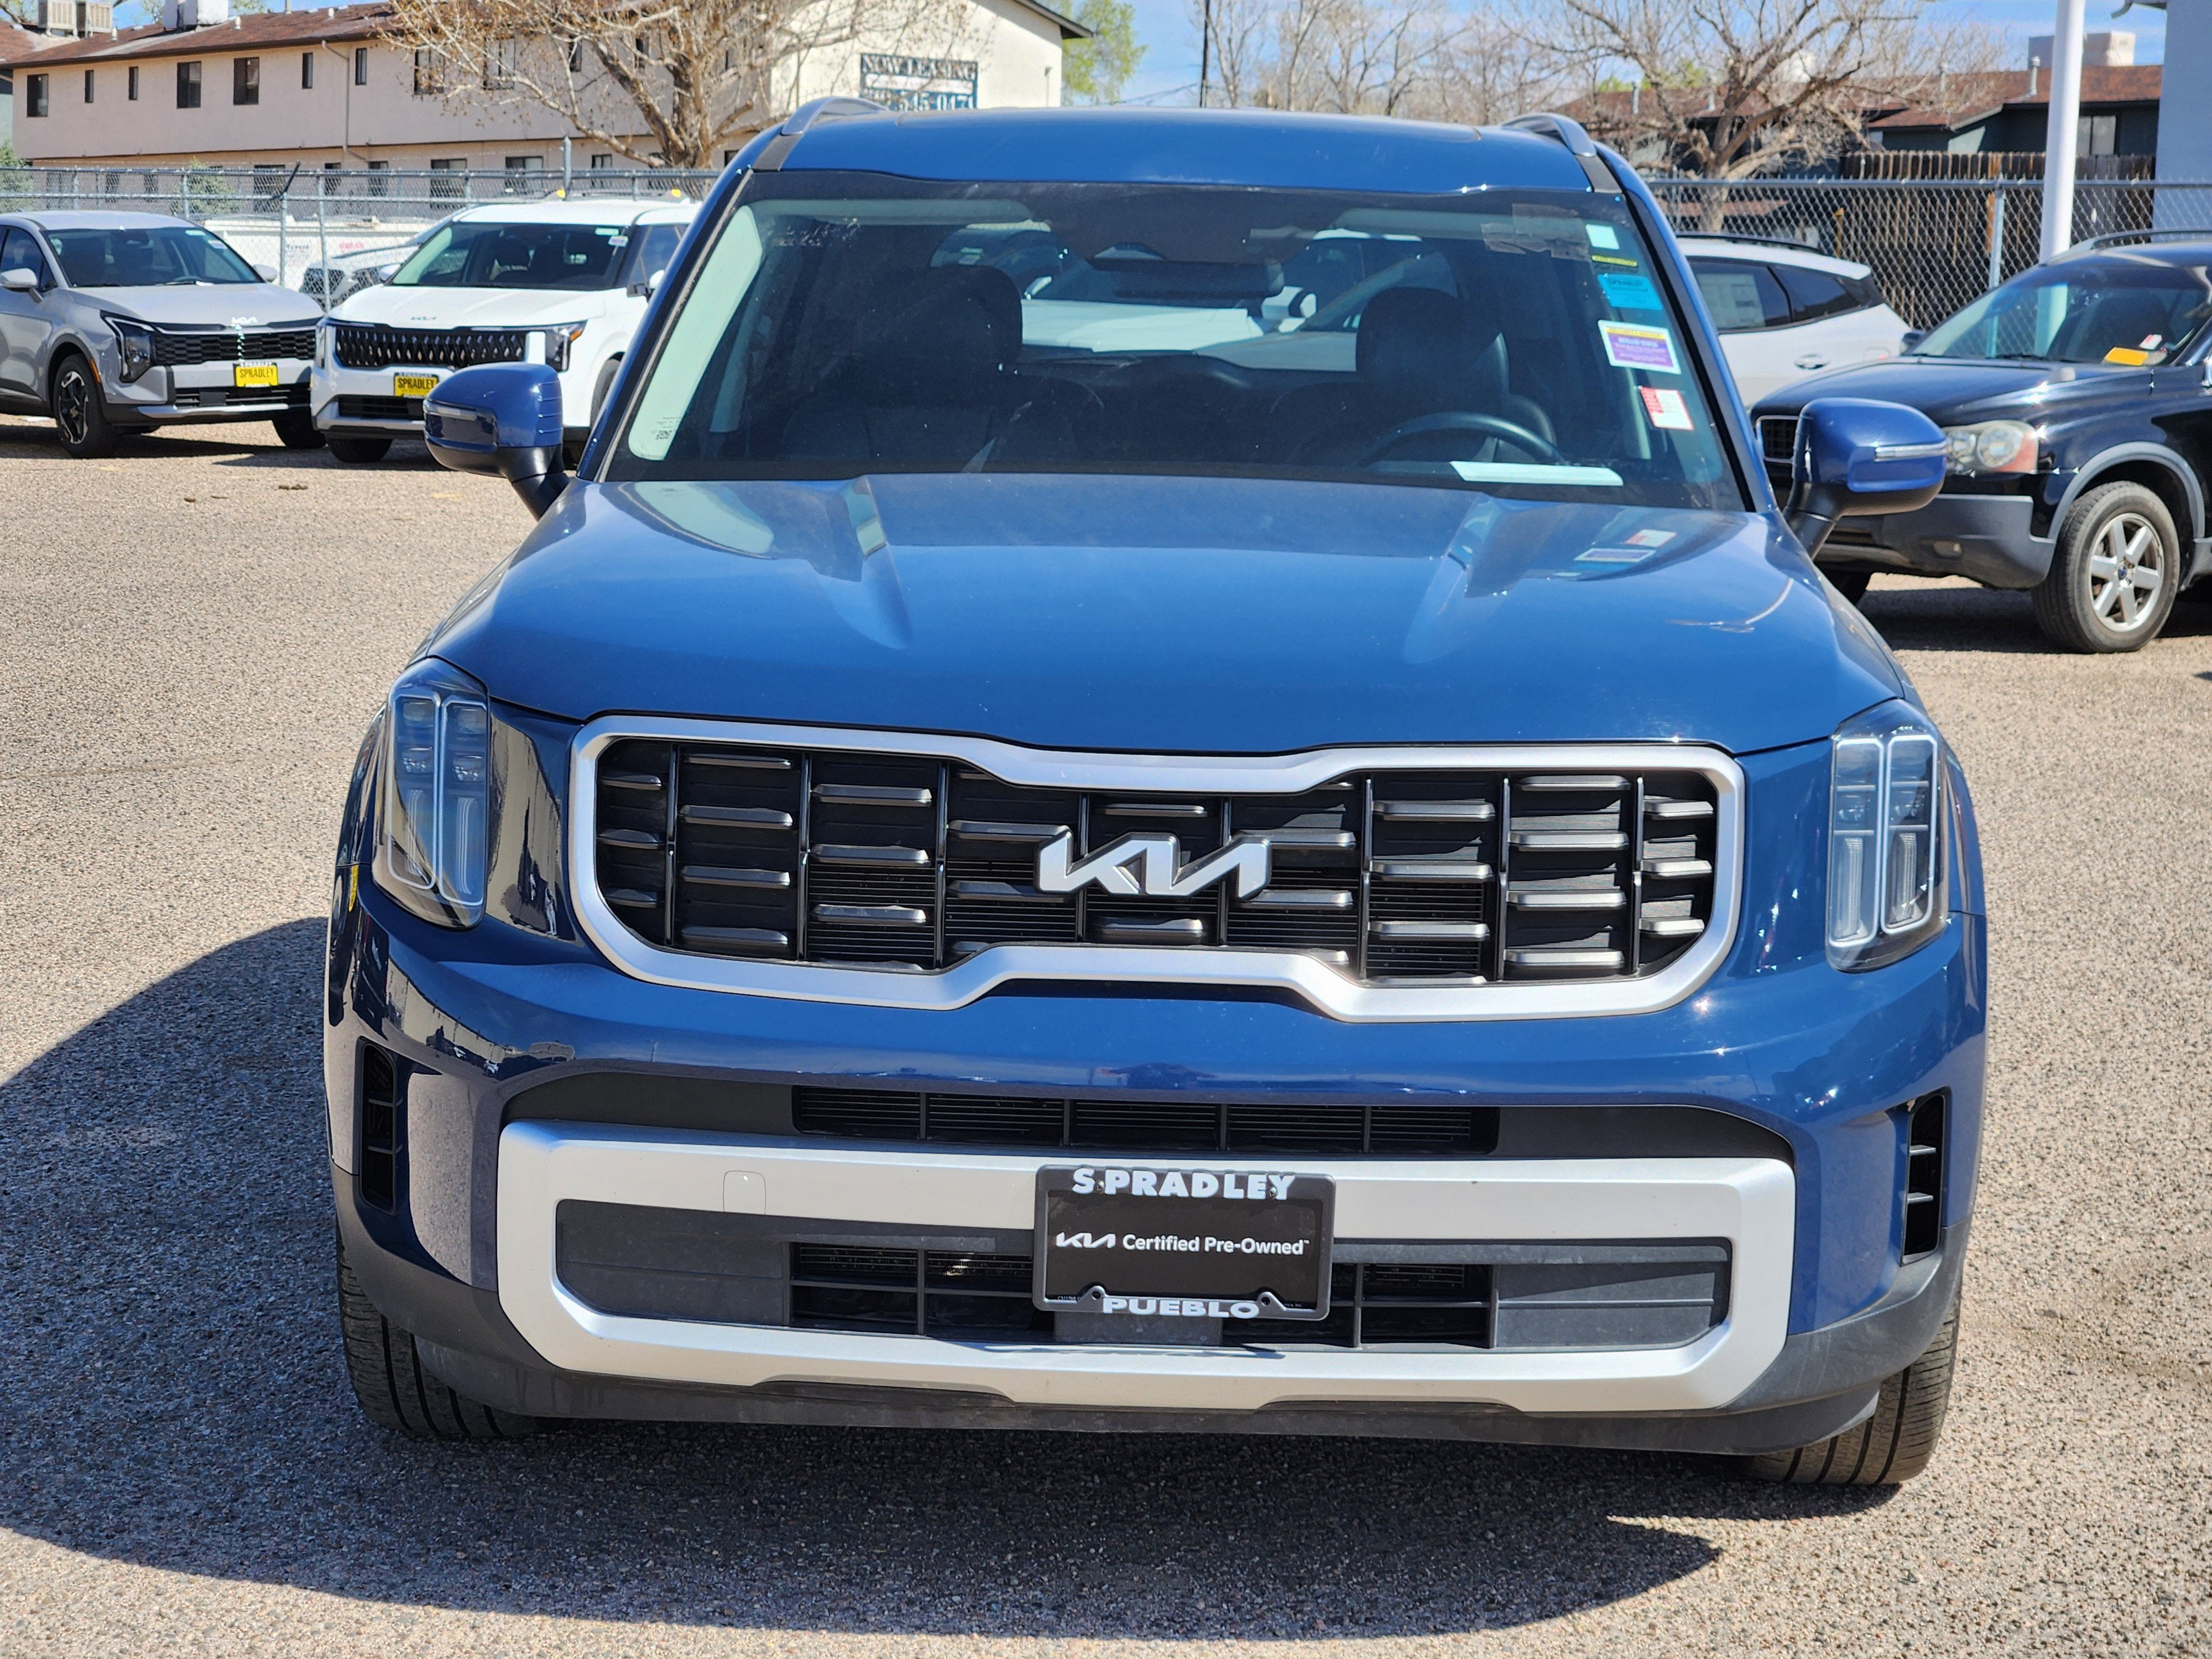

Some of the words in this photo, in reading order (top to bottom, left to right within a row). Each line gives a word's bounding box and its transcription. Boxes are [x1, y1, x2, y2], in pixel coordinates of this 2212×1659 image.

[239, 368, 274, 378] SPRADLEY
[398, 378, 435, 389] SPRADLEY
[1037, 828, 1270, 899] KIA
[1072, 1168, 1295, 1200] SPRADLEY
[1056, 1232, 1116, 1249] KIA
[1122, 1234, 1200, 1252] Certified
[1102, 1297, 1260, 1318] PUEBLO
